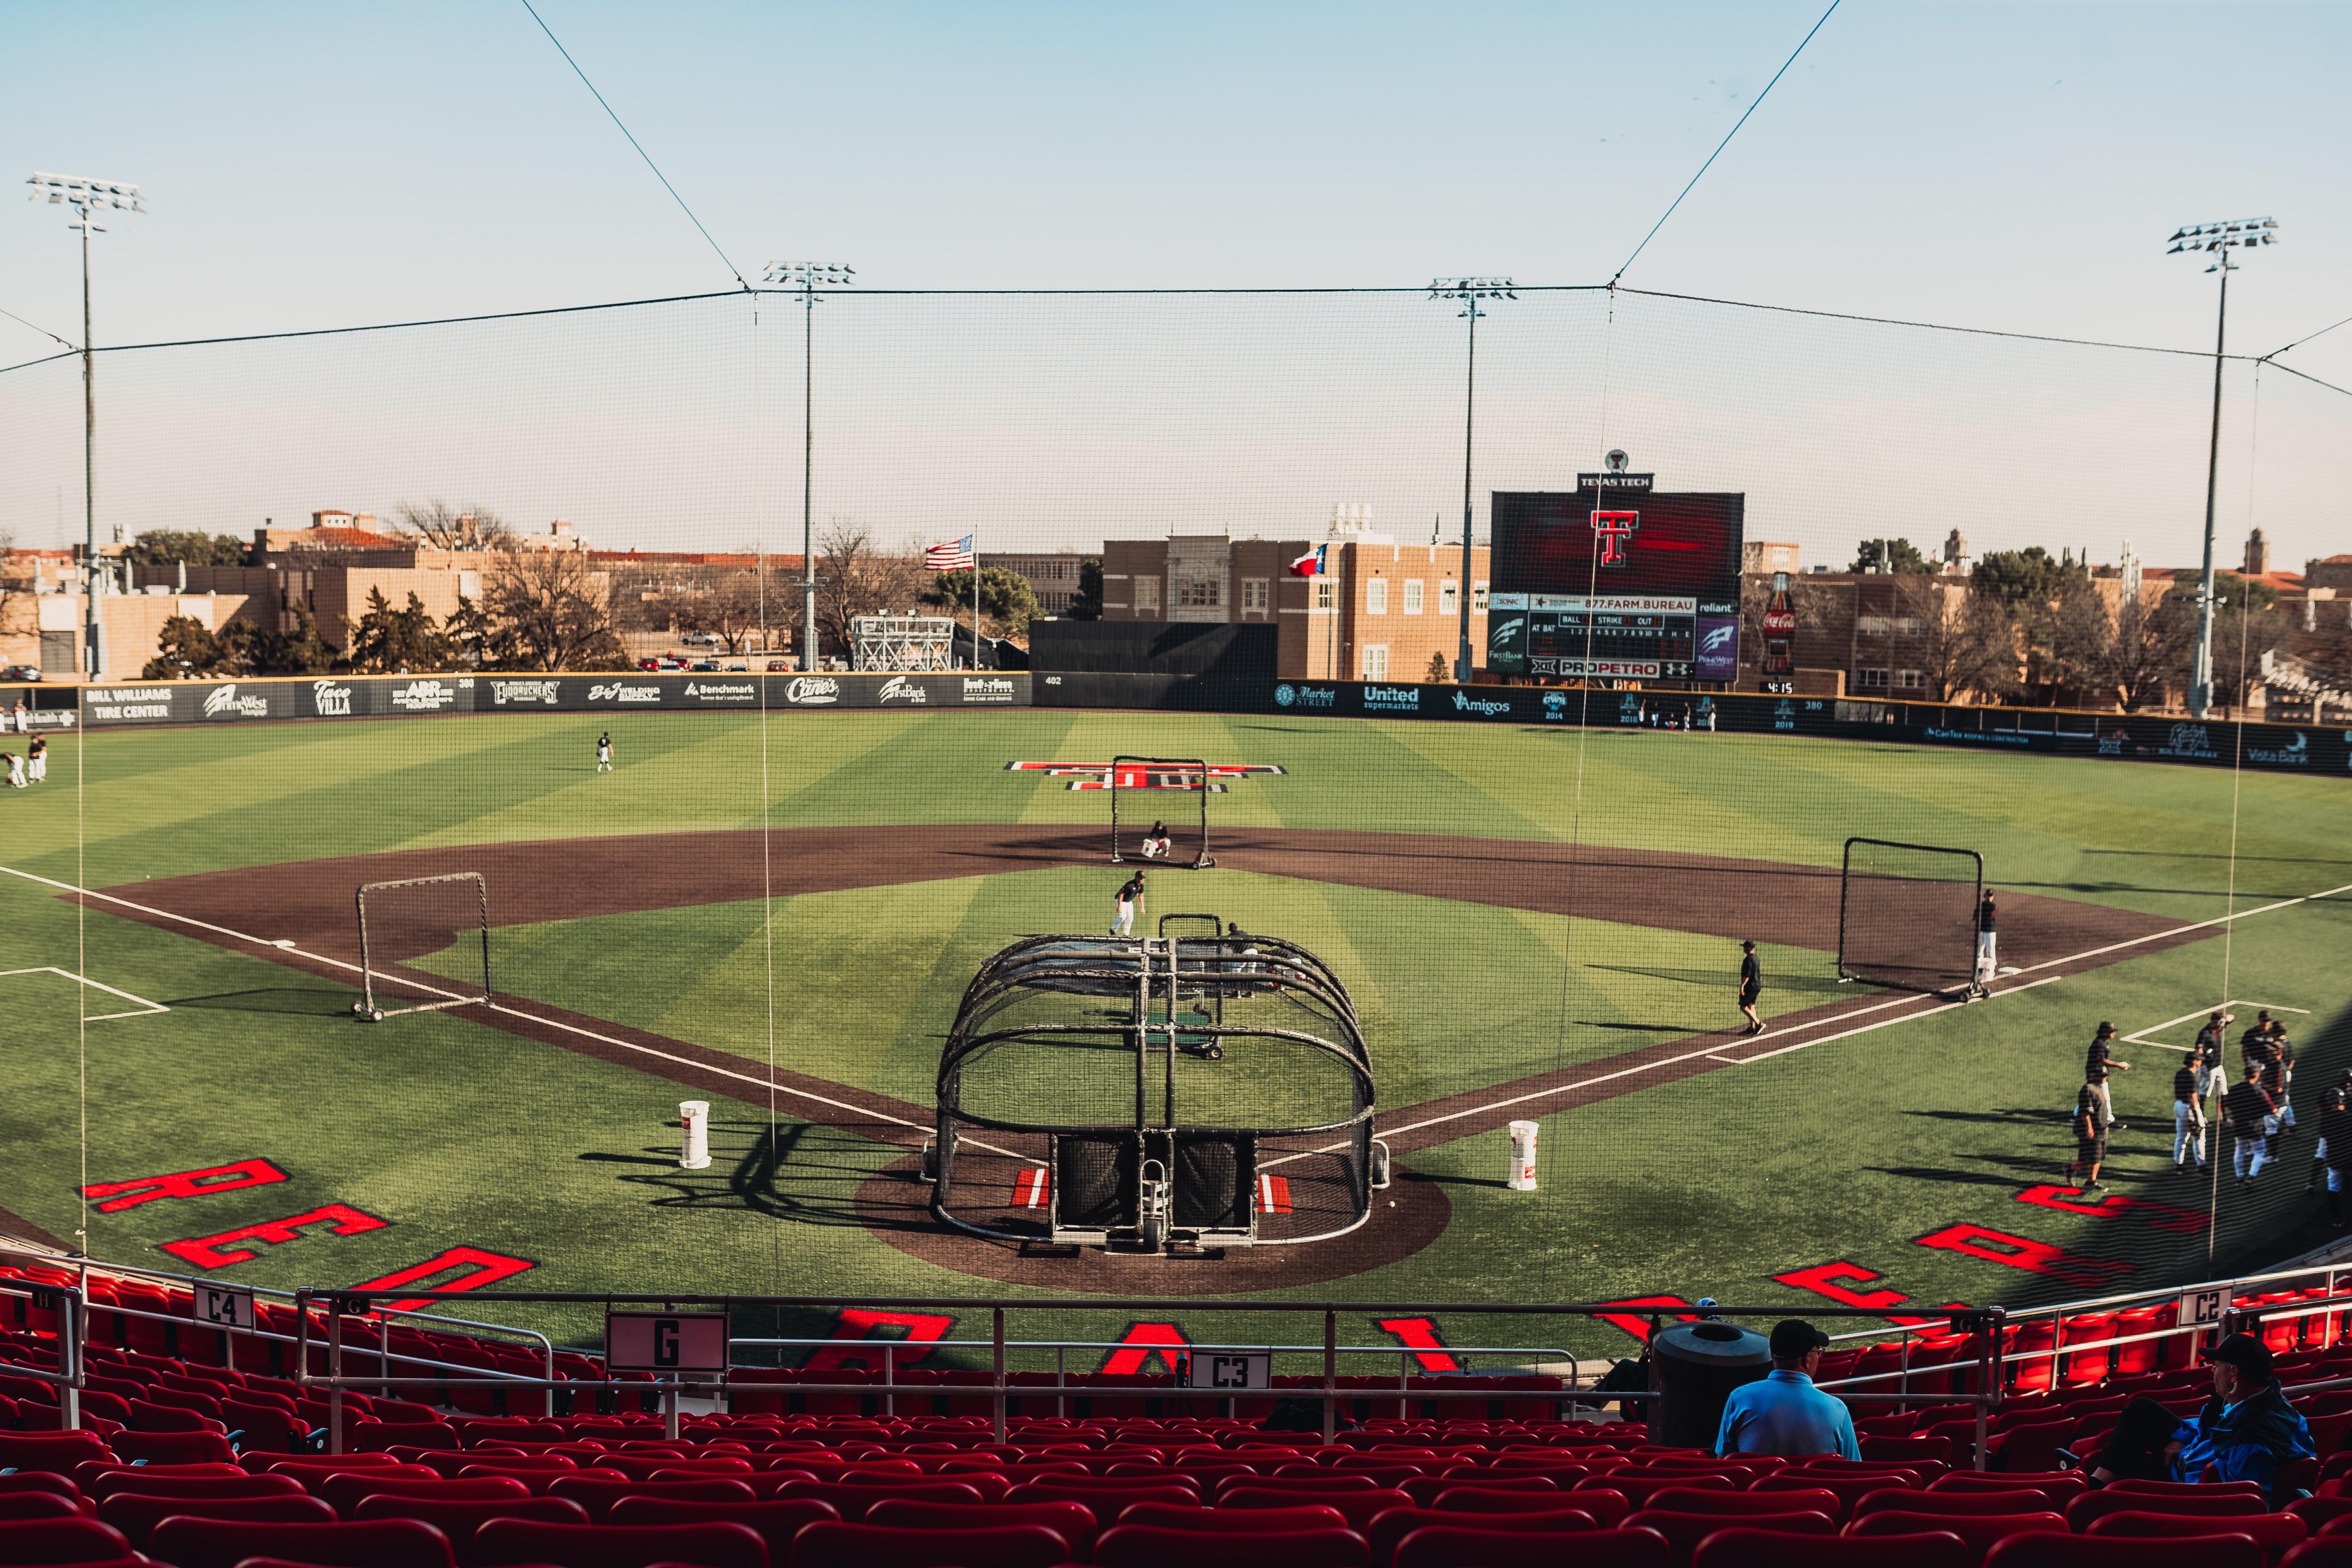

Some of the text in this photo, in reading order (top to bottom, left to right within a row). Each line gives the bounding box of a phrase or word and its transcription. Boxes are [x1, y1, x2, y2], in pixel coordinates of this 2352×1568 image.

[1581, 478, 1649, 486] TEXAS TECH
[1585, 599, 1692, 610] 877.FARM.BUREAU
[1700, 603, 1731, 613] reliant
[1562, 615, 1580, 624] BALL
[1597, 617, 1622, 625] STRIKE
[1638, 617, 1651, 625] OUT
[1562, 662, 1657, 675] PROPETRO
[1046, 676, 1061, 684] 402
[86, 688, 172, 702] BILL WILLIAMS
[314, 680, 351, 699] Taco
[405, 680, 441, 698] ABR
[700, 684, 755, 694] Benchmark
[788, 677, 838, 702] Cane's
[1296, 686, 1335, 698] Market
[1364, 687, 1418, 702] United
[1768, 683, 1793, 694] 4:15
[316, 698, 351, 715] VILLA
[1297, 697, 1334, 706] STREET
[1364, 702, 1418, 710] supermarkets
[1461, 696, 1510, 715] Amigos
[1805, 700, 1823, 710] 380
[94, 704, 169, 719] TIRE CENTER
[1546, 711, 1563, 719] 2014
[1697, 718, 1711, 726] 201
[38, 1292, 49, 1308] H
[208, 1290, 237, 1323] C4
[347, 1299, 361, 1314] G
[2195, 1292, 2220, 1322] C2
[1959, 1318, 1972, 1332] G
[654, 1319, 679, 1366] G
[1212, 1356, 1248, 1388] C3
